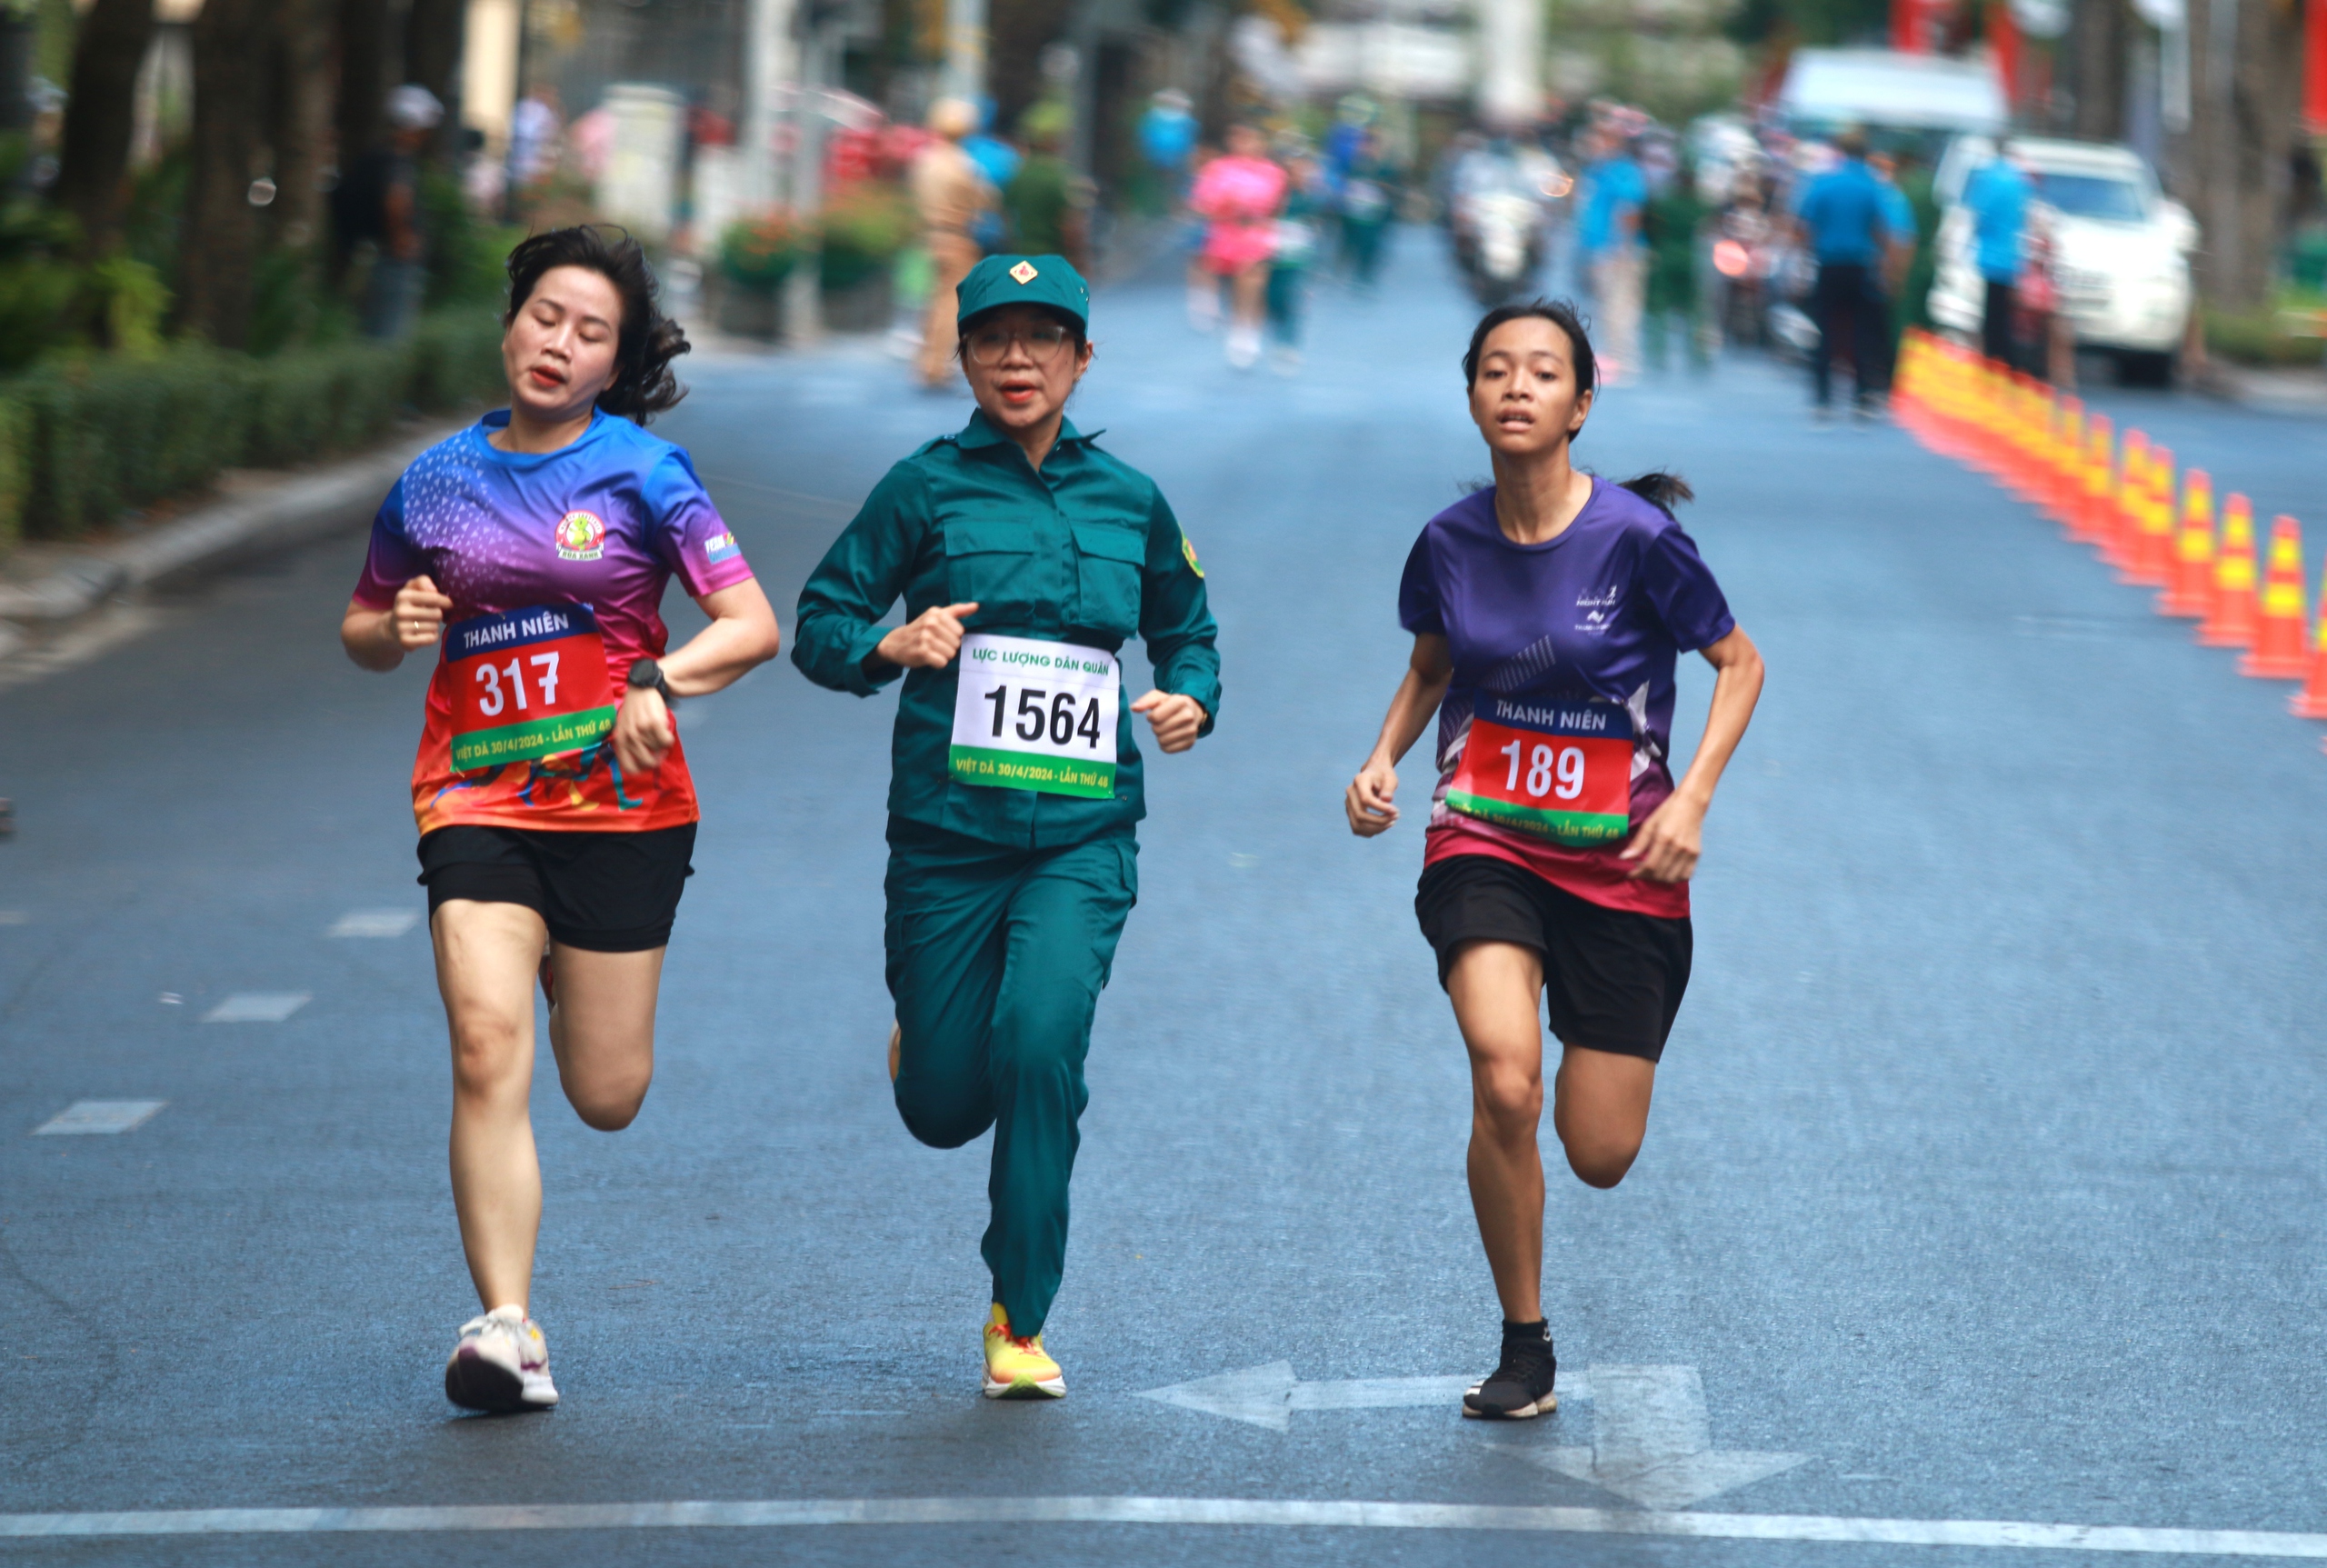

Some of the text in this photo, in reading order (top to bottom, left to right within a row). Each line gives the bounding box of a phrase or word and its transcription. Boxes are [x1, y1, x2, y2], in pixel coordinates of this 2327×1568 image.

[464, 611, 569, 649] THANH NIÊN
[973, 647, 1109, 676] LỰC LƯỢNG DÂN QUÂN
[475, 651, 560, 716] 317
[984, 684, 1100, 749] 1564
[1496, 699, 1607, 731] THANH NIÊN
[456, 744, 473, 763] VIỆT
[491, 734, 544, 754] 30/4/2024
[552, 723, 574, 743] LẦN
[575, 720, 596, 738] THỨ
[956, 756, 977, 775] VIỆT
[998, 763, 1053, 781] 30/4/2024
[1059, 765, 1078, 784] LẦN
[1080, 771, 1097, 787] THỨ
[1097, 775, 1109, 788] 48
[1501, 739, 1584, 800] 189
[1582, 823, 1604, 838] THỨ
